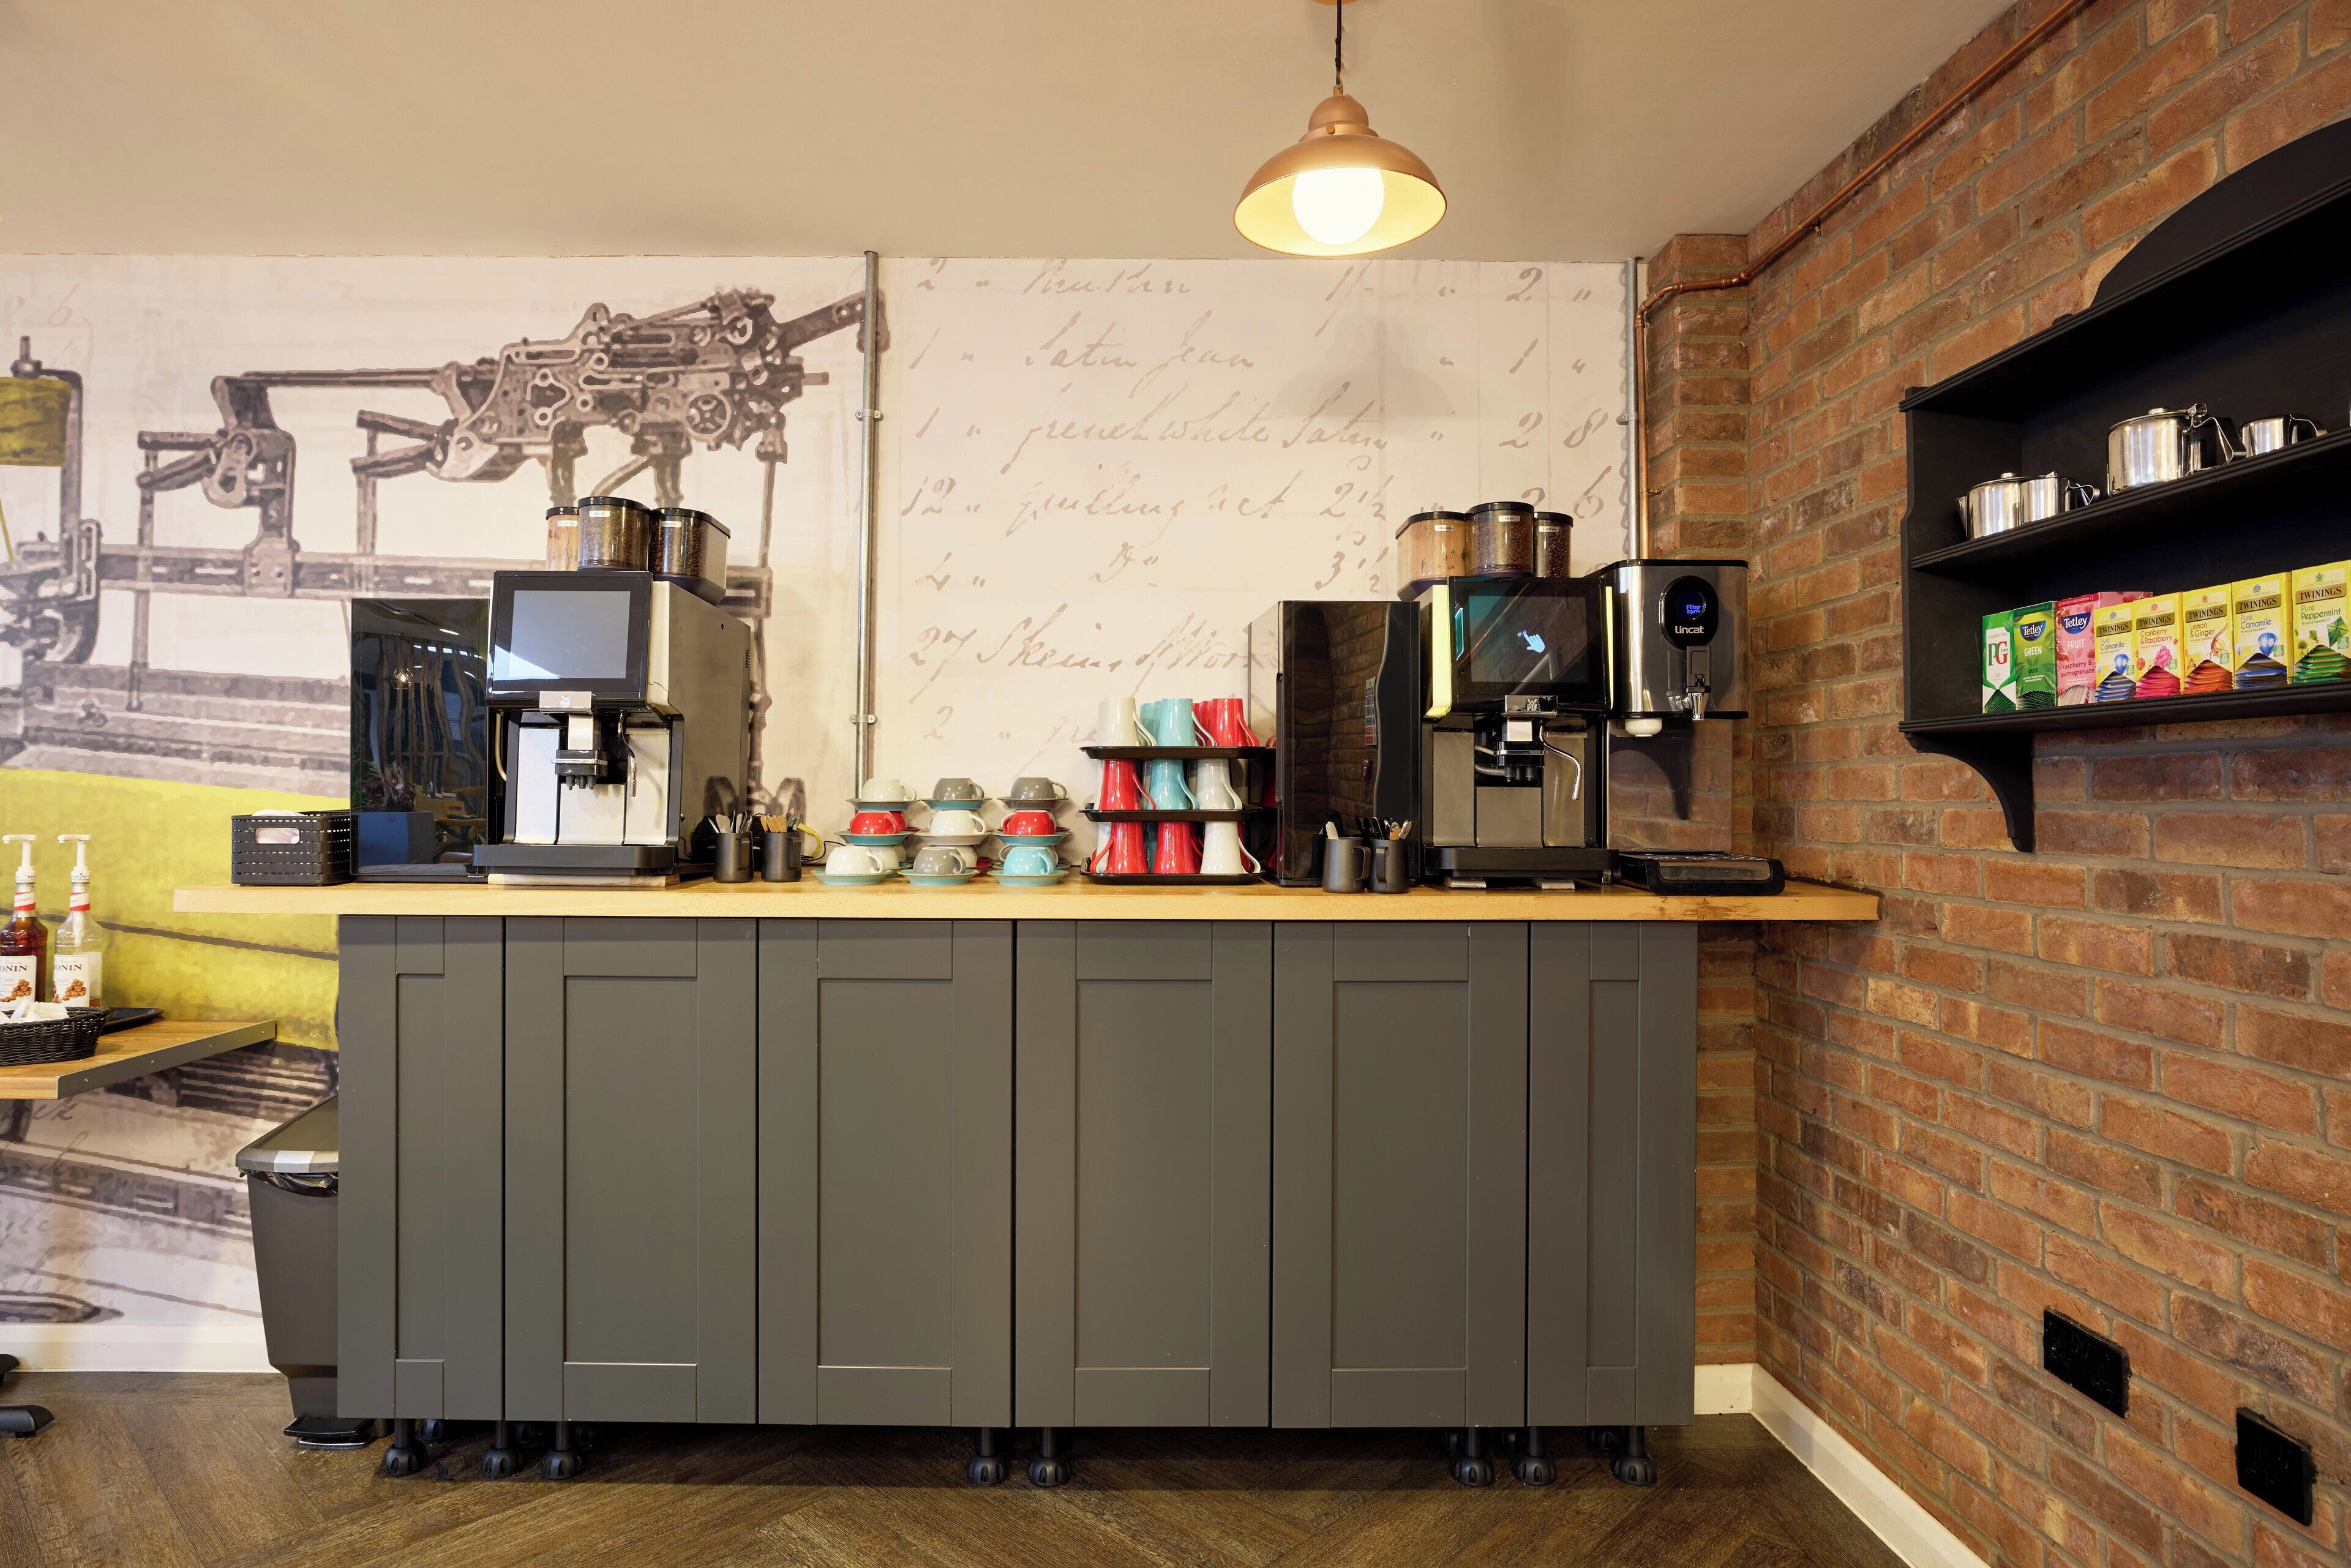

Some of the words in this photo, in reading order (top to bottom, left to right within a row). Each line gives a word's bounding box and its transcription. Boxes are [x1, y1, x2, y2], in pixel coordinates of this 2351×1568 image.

[2300, 587, 2342, 601] TWININGS
[2239, 597, 2277, 611] TWININGS
[2189, 607, 2224, 620] TWININGS
[2301, 608, 2341, 620] Peppermint
[2064, 617, 2088, 629] Tetley
[2139, 615, 2172, 627] TWININGS
[2240, 618, 2272, 629] Camomile
[2022, 625, 2042, 636] Tetley
[2099, 623, 2129, 634] TWININGS
[2140, 629, 2167, 637] Cranberry
[2068, 639, 2085, 650] FRUIT
[2100, 641, 2125, 650] Camomile
[1987, 641, 2008, 666] PG
[2024, 645, 2042, 656] GREEN
[2063, 661, 2087, 670] raspberry
[2061, 669, 2095, 678] pomegranate
